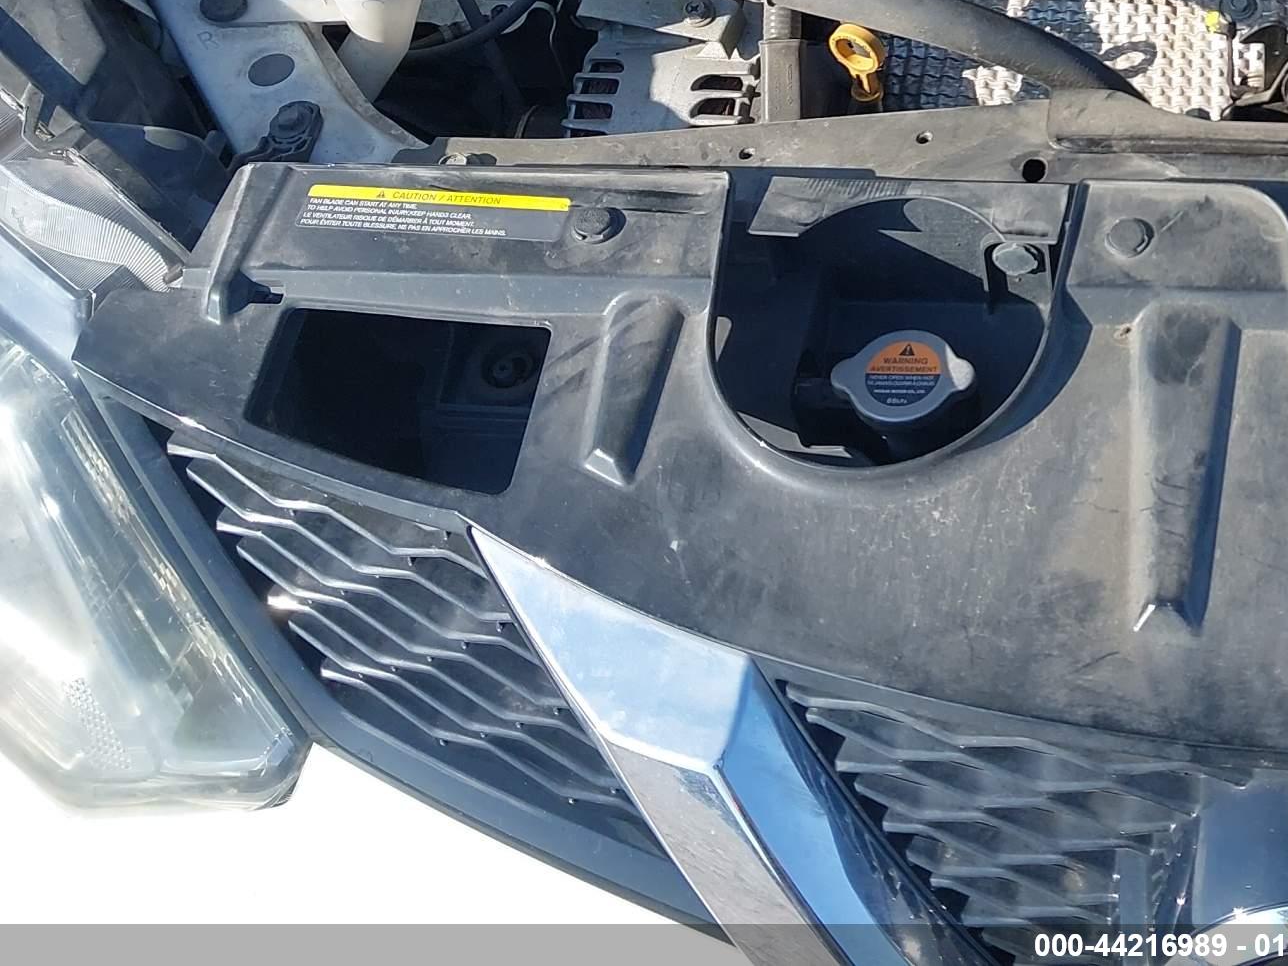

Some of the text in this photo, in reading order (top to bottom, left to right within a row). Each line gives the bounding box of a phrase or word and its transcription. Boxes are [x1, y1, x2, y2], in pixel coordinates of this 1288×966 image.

[392, 191, 437, 202] CAUTION
[446, 194, 502, 205] ATTENTION
[316, 204, 333, 212] HELP
[333, 205, 353, 213] AVOID
[354, 207, 387, 215] PERSONAL
[312, 212, 353, 220] VENTILATEUR
[429, 218, 445, 226] TOUT
[883, 357, 929, 365] WARNING
